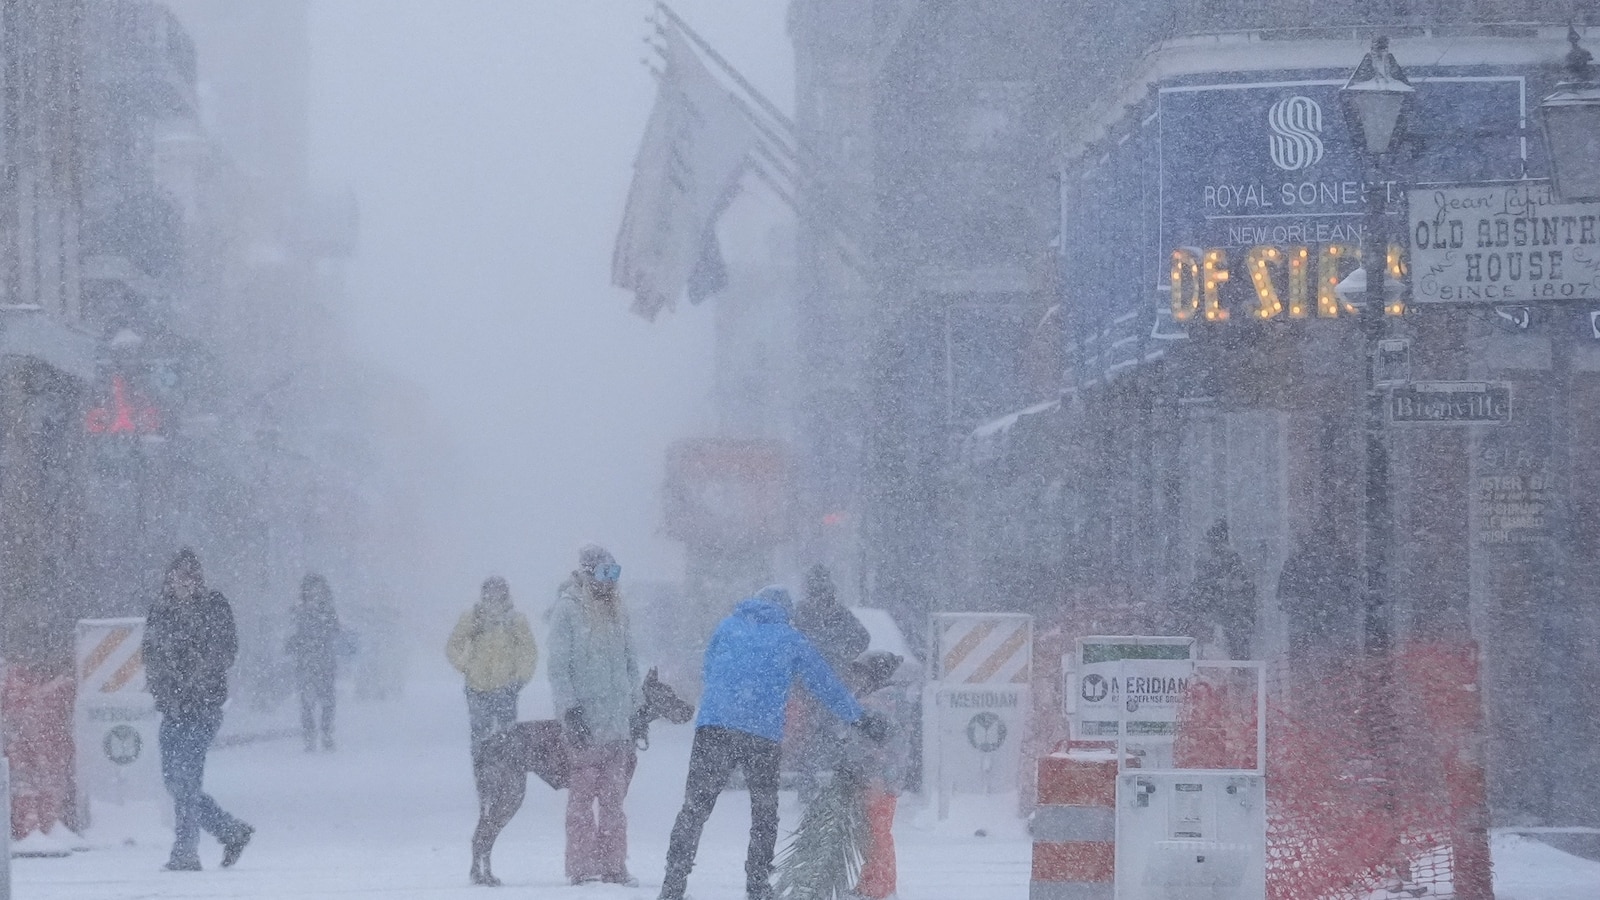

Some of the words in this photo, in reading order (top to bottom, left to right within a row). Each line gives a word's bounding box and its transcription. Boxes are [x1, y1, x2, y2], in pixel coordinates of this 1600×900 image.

[1204, 184, 1273, 208] ROYAL
[1281, 181, 1404, 206] SONET
[1229, 226, 1267, 244] NEW
[1272, 223, 1368, 243] ORLEAN
[1415, 219, 1464, 249] OLD
[1476, 214, 1600, 248] ABSINTH
[1464, 250, 1563, 282] HOUSE
[1439, 285, 1517, 300] SINCE
[1532, 281, 1591, 297] 1807
[1397, 396, 1507, 417] Bienville
[950, 692, 1017, 708] MERIDIAN
